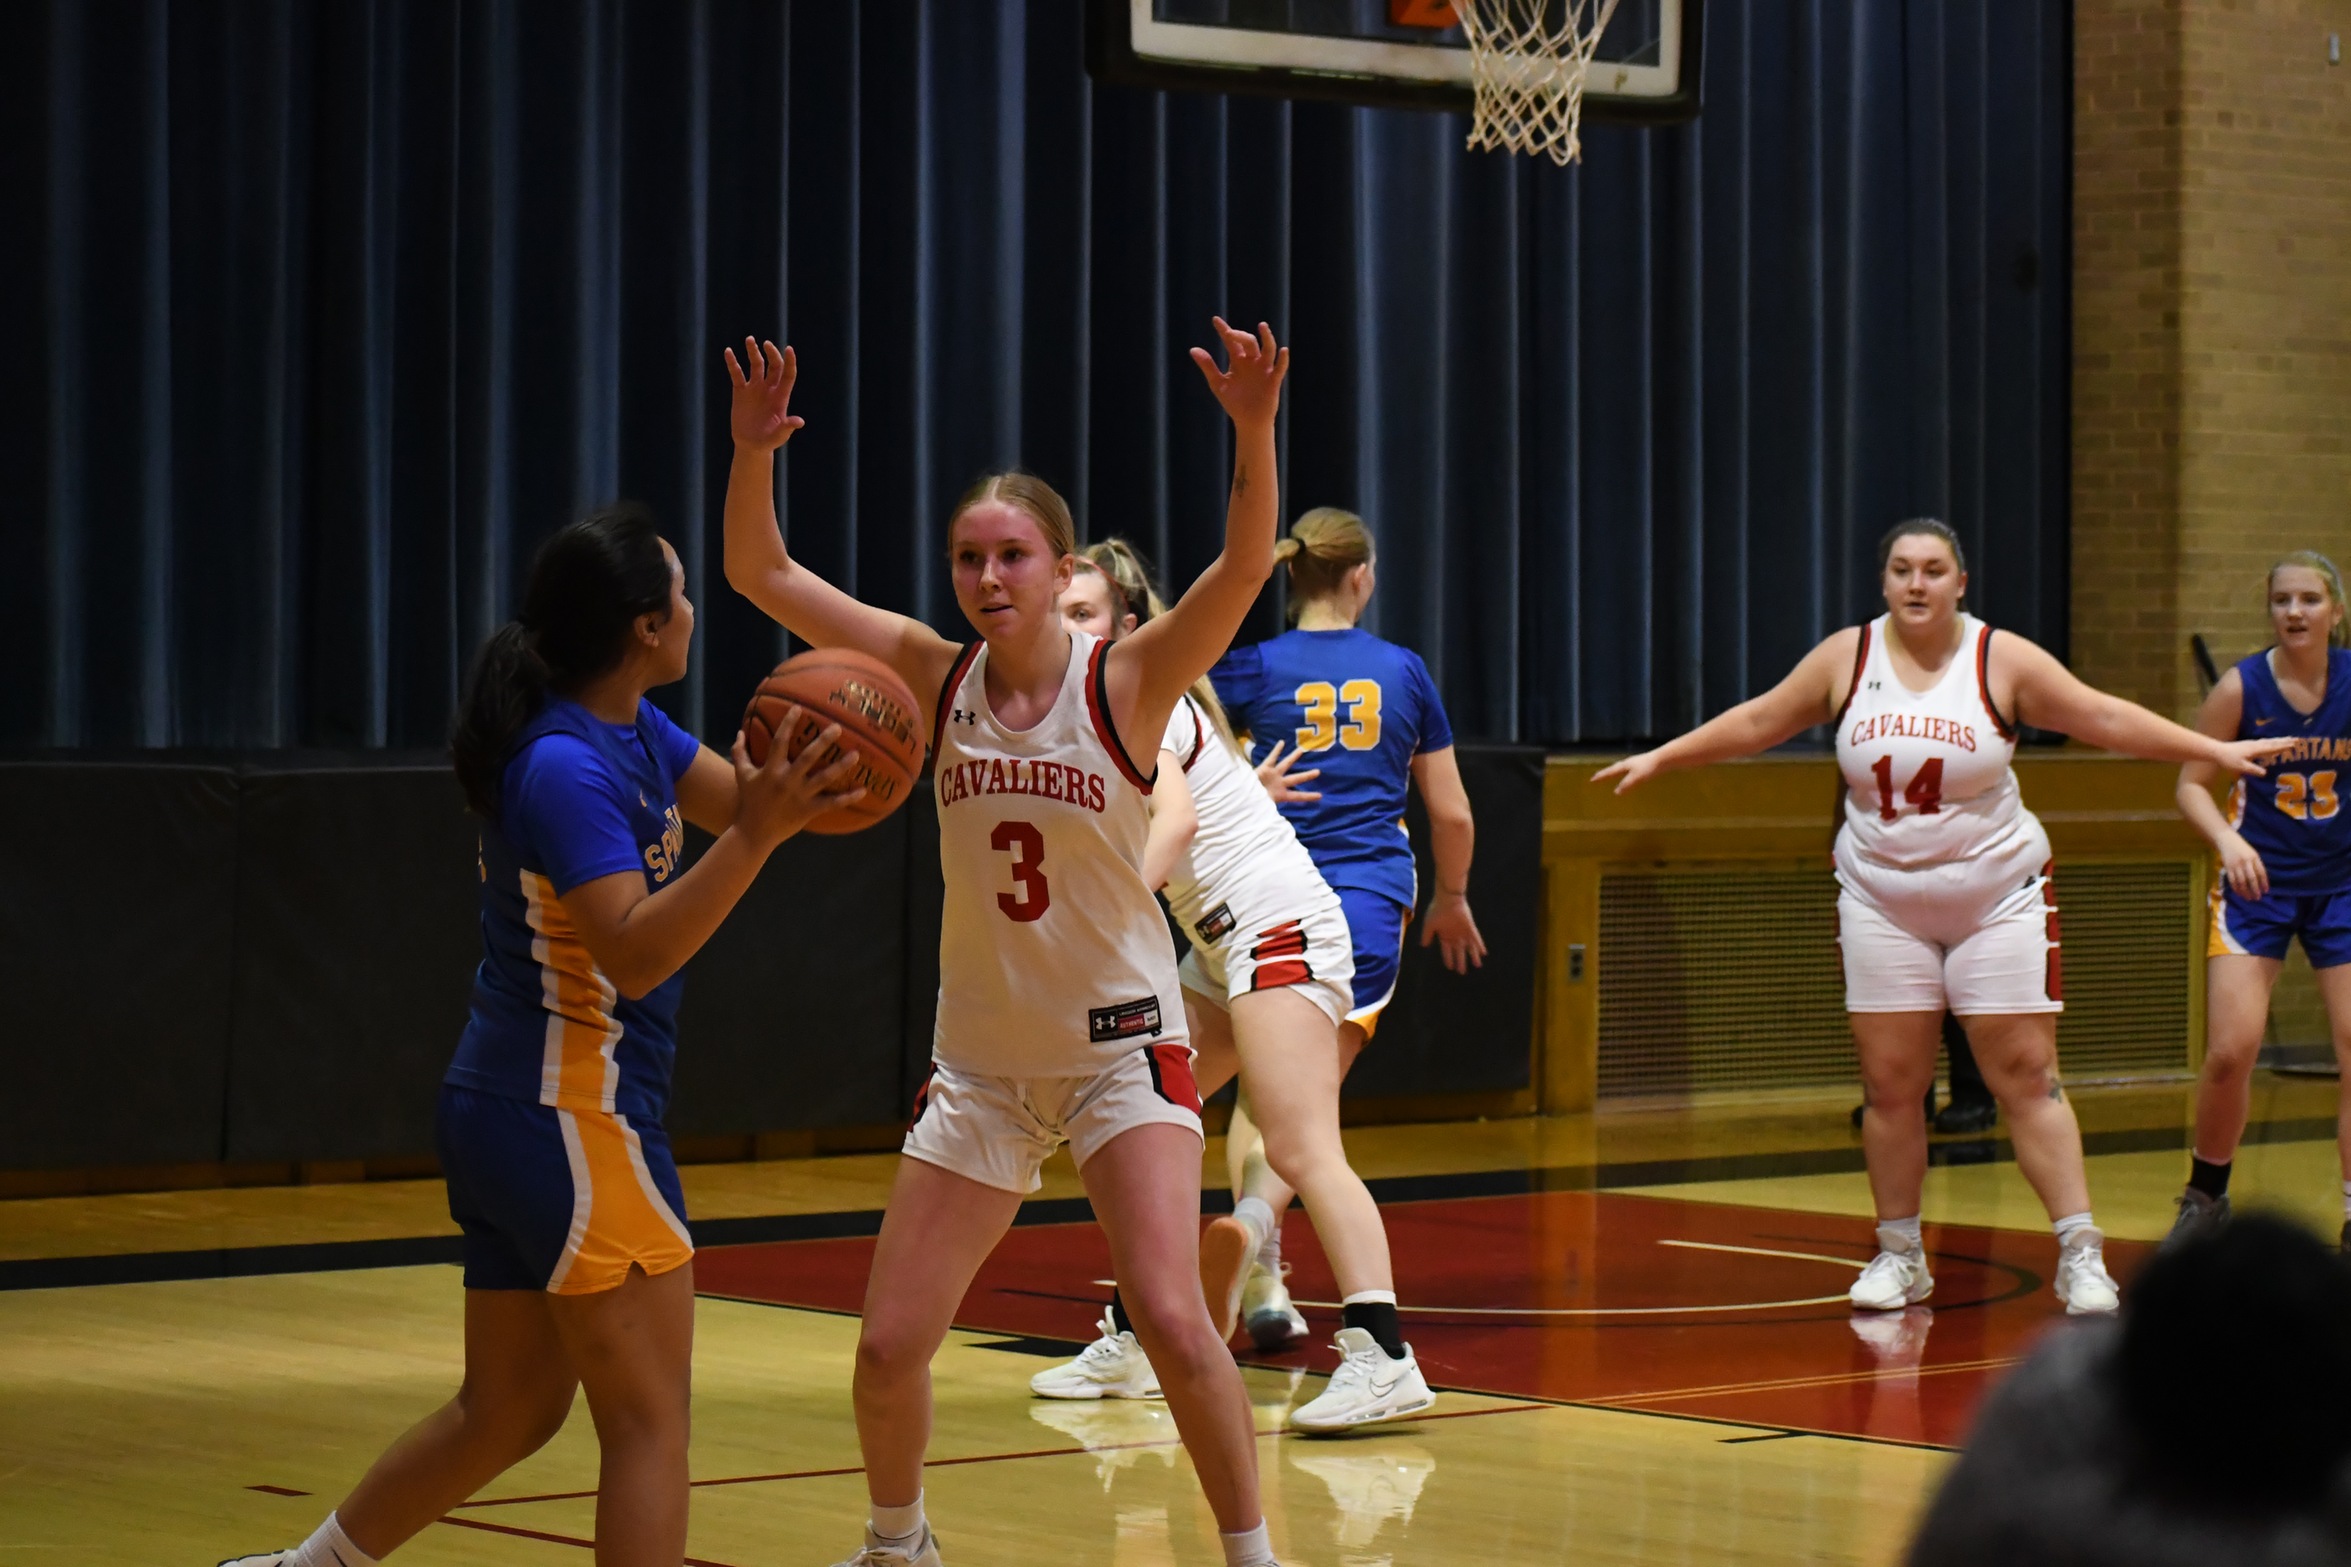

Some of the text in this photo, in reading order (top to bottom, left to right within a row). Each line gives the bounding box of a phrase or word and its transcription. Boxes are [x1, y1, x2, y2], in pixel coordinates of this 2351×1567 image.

[1294, 679, 1382, 752] 33
[1851, 713, 1976, 753] CAVALIERS
[940, 758, 1106, 813] CAVALIERS
[1871, 755, 1944, 821] 14
[2274, 769, 2339, 820] 23
[990, 821, 1050, 922] 3
